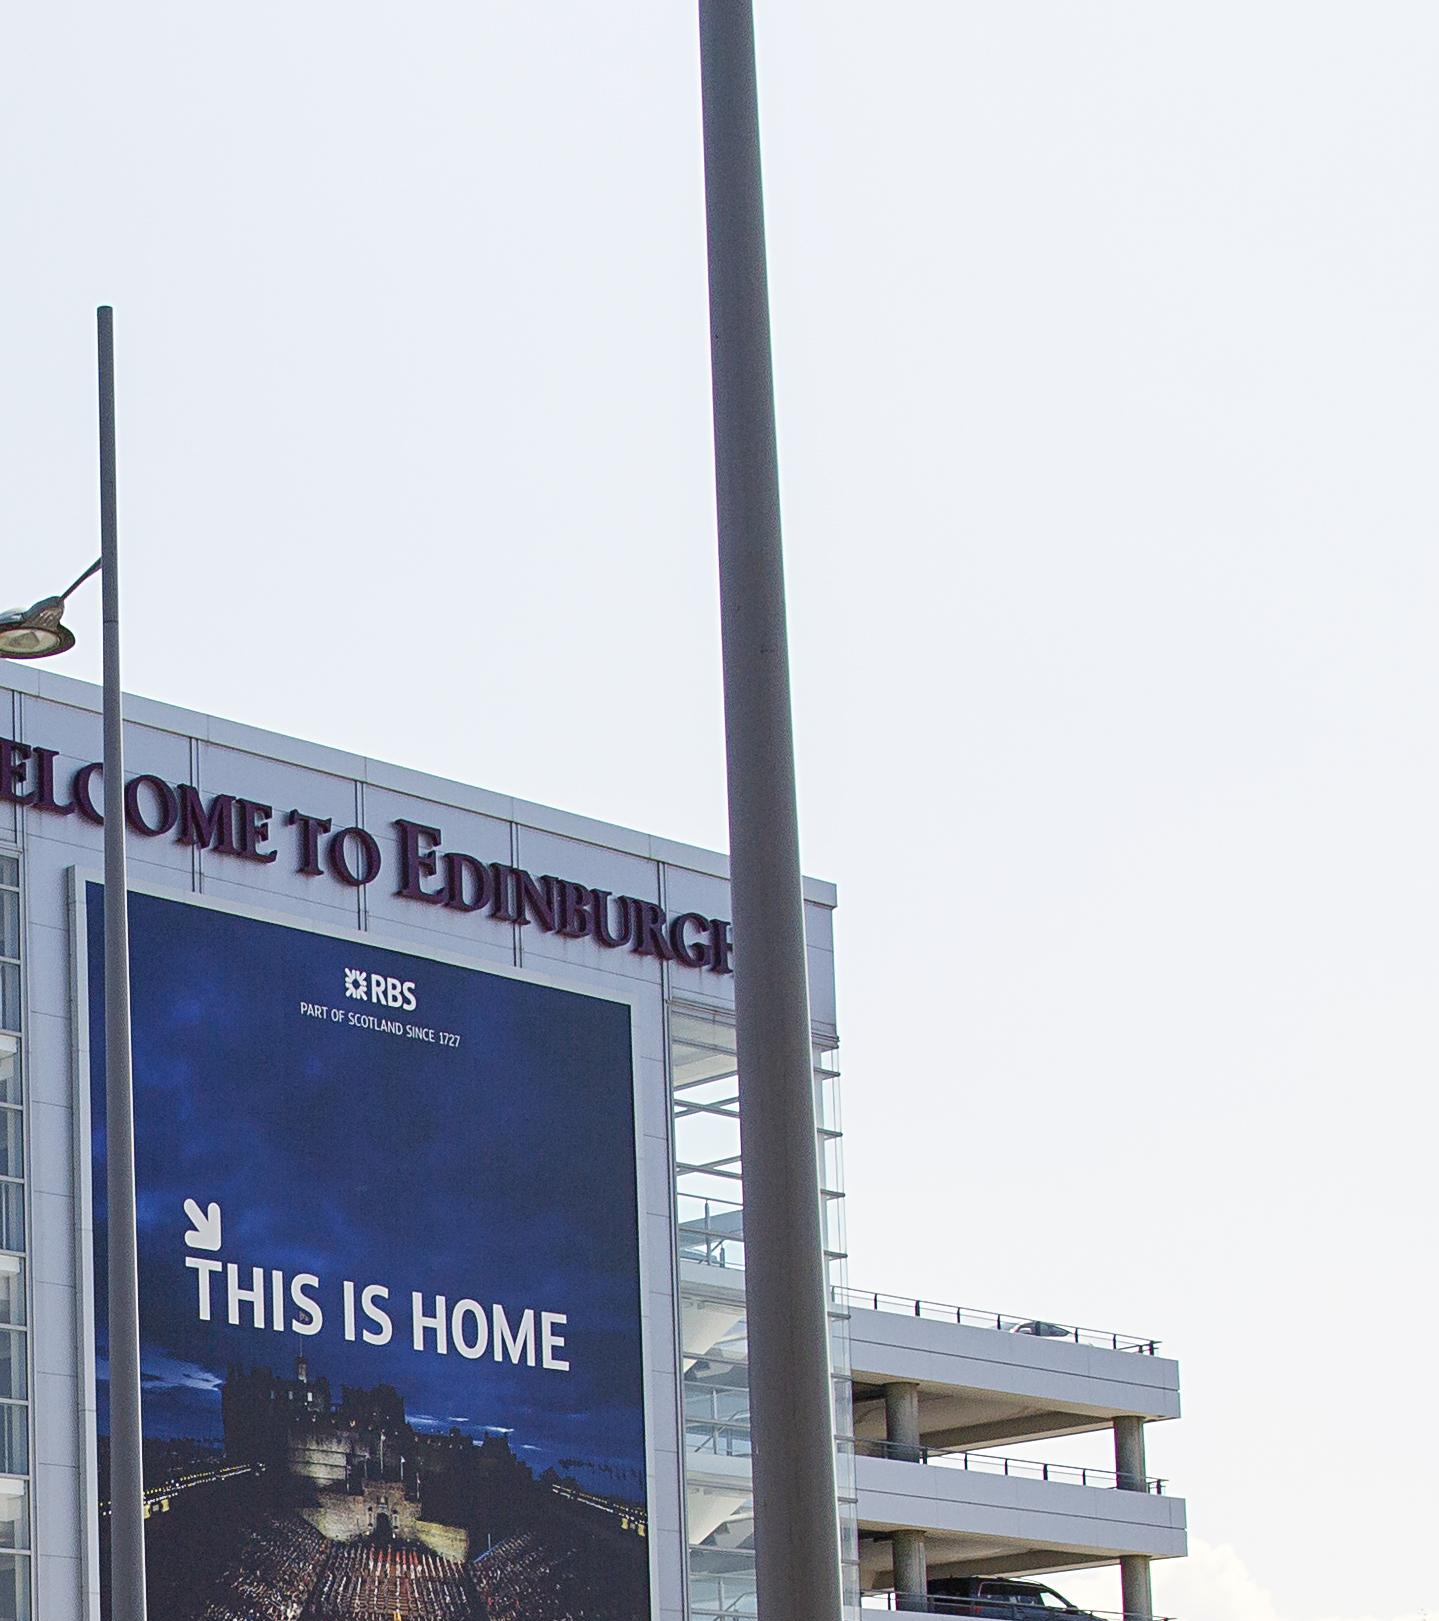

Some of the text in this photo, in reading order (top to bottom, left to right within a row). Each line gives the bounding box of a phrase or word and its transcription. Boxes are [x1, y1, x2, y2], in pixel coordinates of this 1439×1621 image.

[288, 808, 381, 887] TO
[371, 974, 417, 1011] RBS
[300, 1002, 461, 1047] PART OF SCOTLAND SINCE 1727
[185, 1256, 570, 1372] THIS IS HOME
